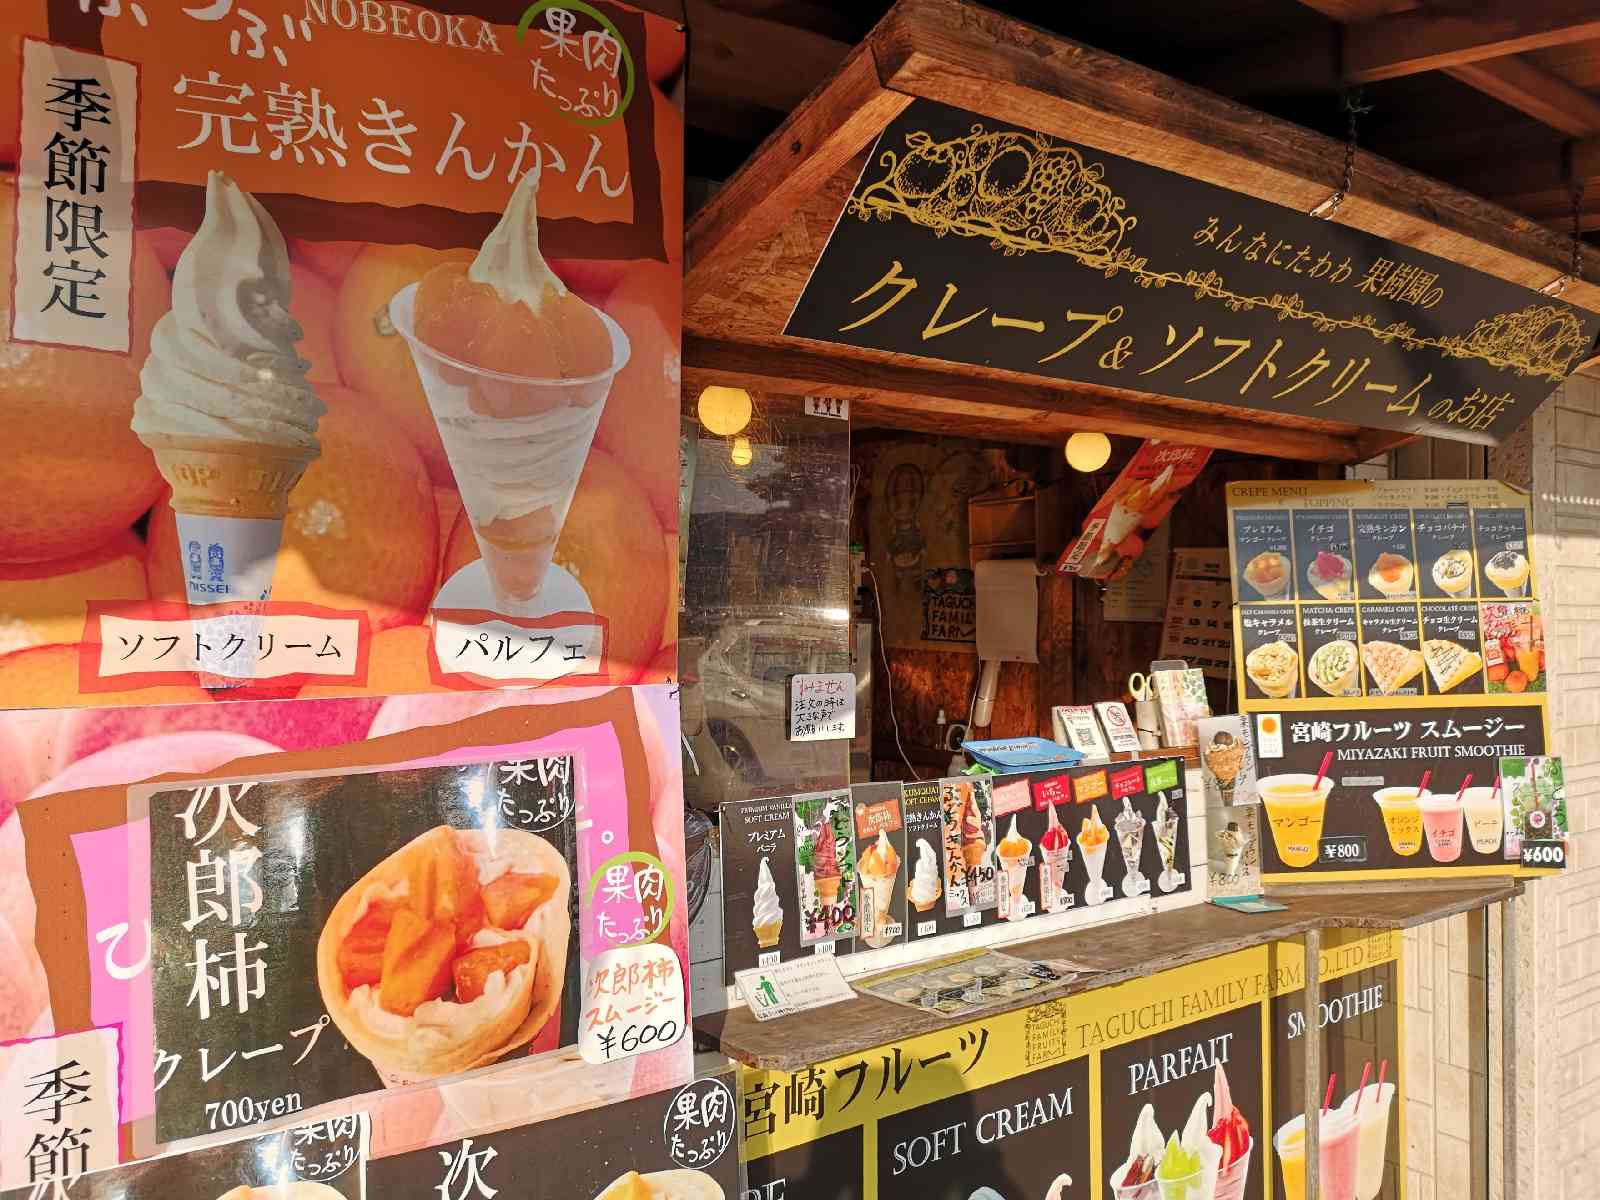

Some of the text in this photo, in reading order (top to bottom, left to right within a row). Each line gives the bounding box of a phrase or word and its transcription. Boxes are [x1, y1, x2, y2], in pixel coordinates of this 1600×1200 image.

[304, 0, 504, 54] NOBEOKA
[540, 7, 622, 79] 果肉
[529, 57, 619, 119] たっぷり
[172, 70, 630, 198] 完熟きんかん
[41, 76, 112, 319] 季節限定
[1193, 216, 1444, 310] みんなにたわわ 果樹園の
[1231, 486, 1309, 497] CREPE MENU
[1307, 524, 1335, 534] イチゴ
[1416, 523, 1468, 533] チョコバナナ
[928, 594, 976, 609] TAGUC
[1423, 616, 1478, 625] チョコ生クリーム
[117, 630, 343, 663] ソフトクリーム
[456, 634, 588, 663] パルフェ
[1290, 717, 1526, 744] 宮崎フルーツ スムージー
[1337, 745, 1526, 760] MIYAZAKI FRUIT SMOOTHIE
[497, 791, 576, 823] たっぷり
[1272, 816, 1321, 828] マンゴー
[747, 828, 786, 843] プレミアム
[1325, 844, 1360, 859] ¥800
[1522, 846, 1565, 864] ¥600
[174, 783, 269, 1021] 次郎柿
[601, 864, 664, 906] 果肉
[596, 907, 664, 944] たっぷり
[805, 903, 855, 935] ¥400
[589, 957, 676, 996] 次郎柿
[585, 992, 677, 1032] スムージー
[1076, 999, 1173, 1049] TAGUCHI
[1181, 977, 1249, 1019] FAMILY
[1255, 963, 1302, 996] FARM
[1318, 945, 1364, 977] O.,LTD
[153, 1014, 331, 1092] クレープ
[597, 1019, 677, 1059] ¥600
[1127, 1032, 1233, 1096] PARFAIT
[743, 1027, 989, 1142] 宮崎フルーツ
[24, 1058, 93, 1183] 季節
[205, 1091, 304, 1132] 700yen
[673, 1085, 728, 1131] 果肉
[671, 1129, 727, 1164] たっぷり
[892, 1086, 1075, 1176] SOFT CREAM
[289, 1145, 354, 1176] たっぷり
[435, 1137, 499, 1200] 次
